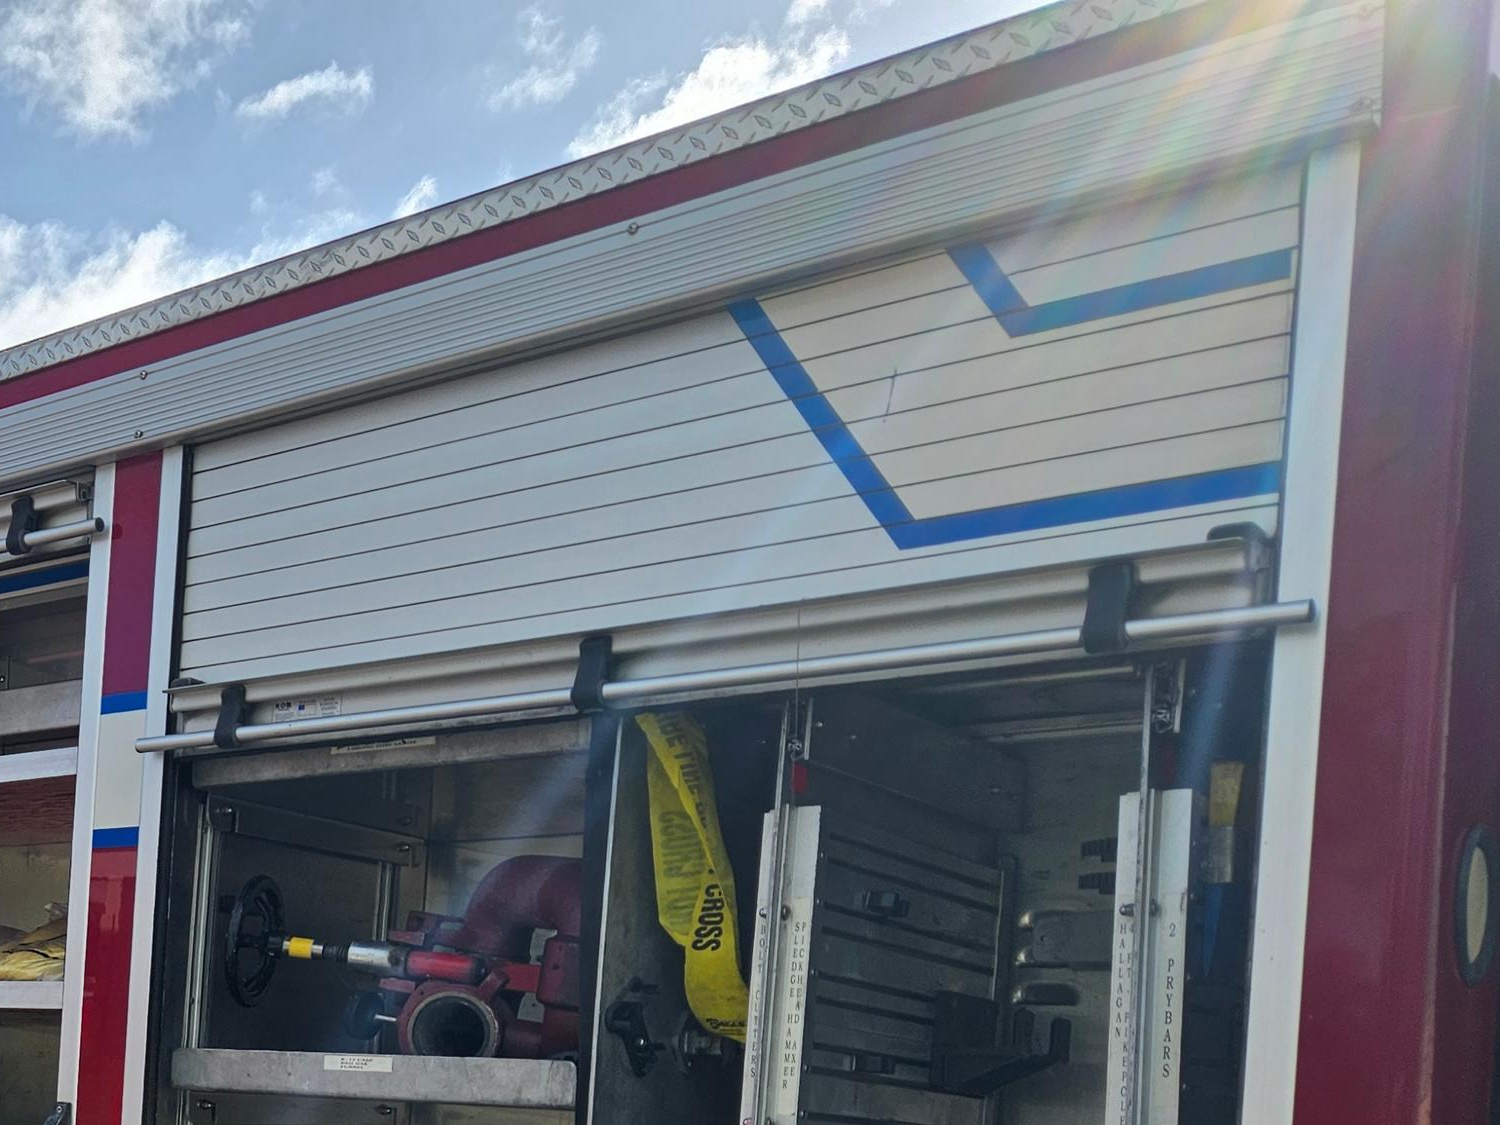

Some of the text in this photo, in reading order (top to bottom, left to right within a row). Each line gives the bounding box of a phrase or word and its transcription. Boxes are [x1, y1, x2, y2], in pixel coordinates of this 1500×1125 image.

[692, 884, 724, 951] CROSS
[1115, 922, 1127, 1039] HALLAGAN
[782, 922, 801, 1090] SLEDGE HAMMER
[790, 921, 808, 1077] PICKHEAD AXE
[1161, 922, 1177, 1079] 2 PRYBARS
